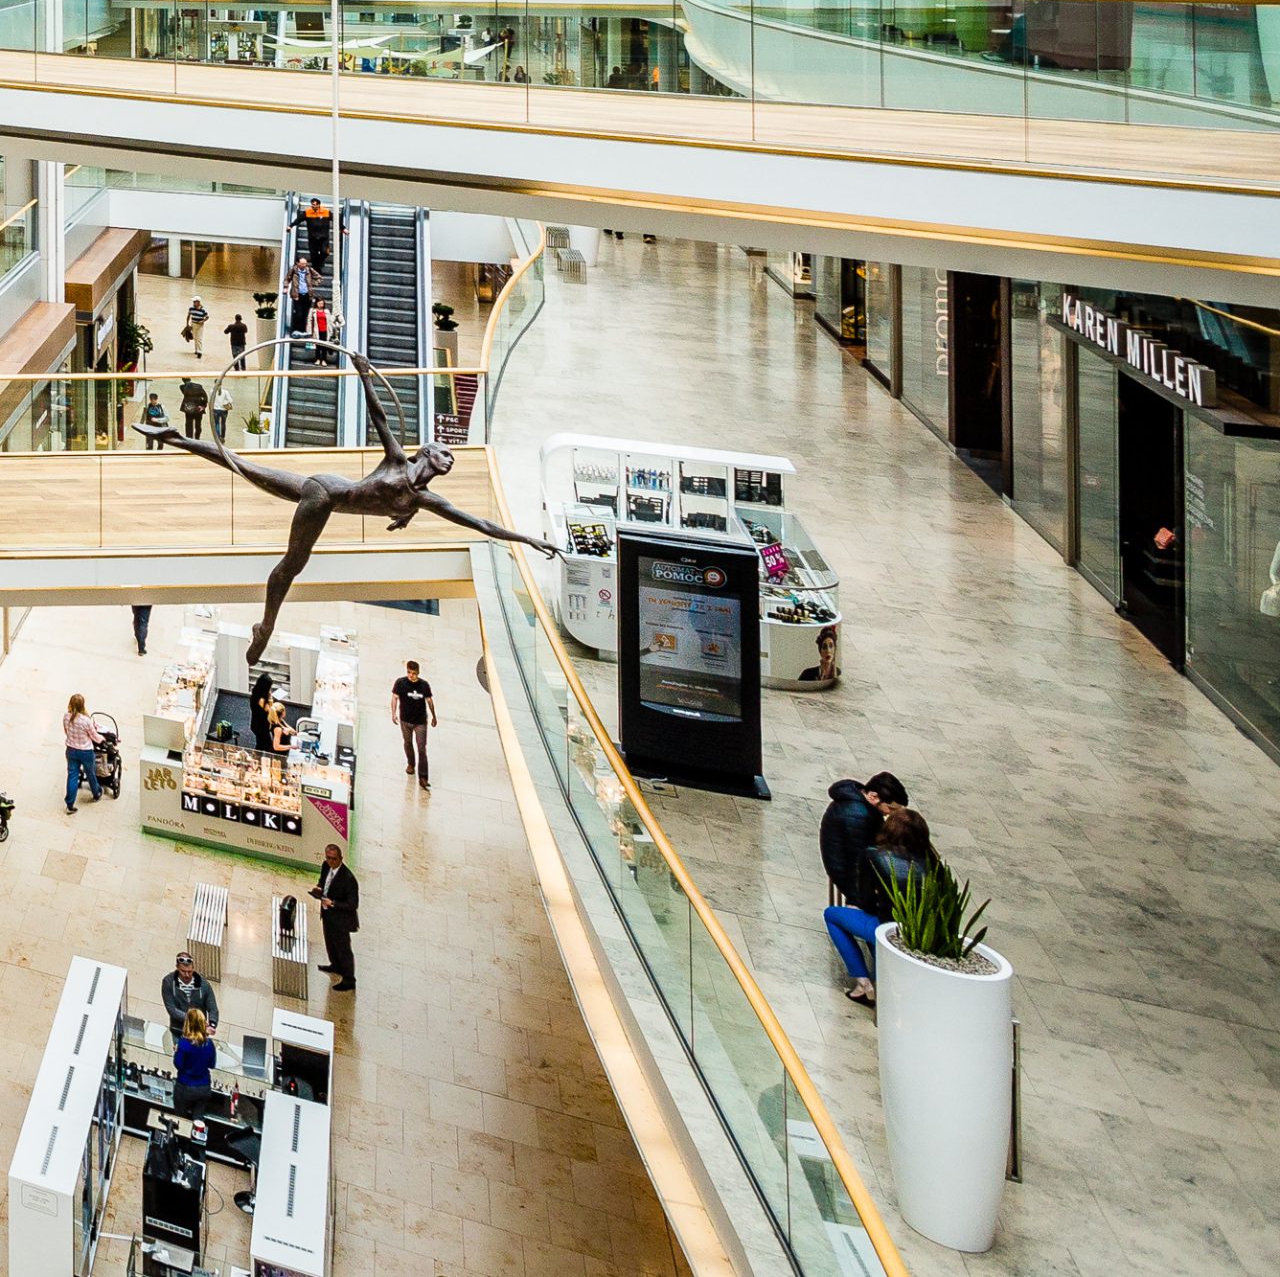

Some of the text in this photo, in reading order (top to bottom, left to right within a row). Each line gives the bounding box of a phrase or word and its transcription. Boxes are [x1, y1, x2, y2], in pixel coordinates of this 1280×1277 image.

[1063, 292, 1203, 407] KAREN MILLEN
[655, 569, 704, 583] POMOC
